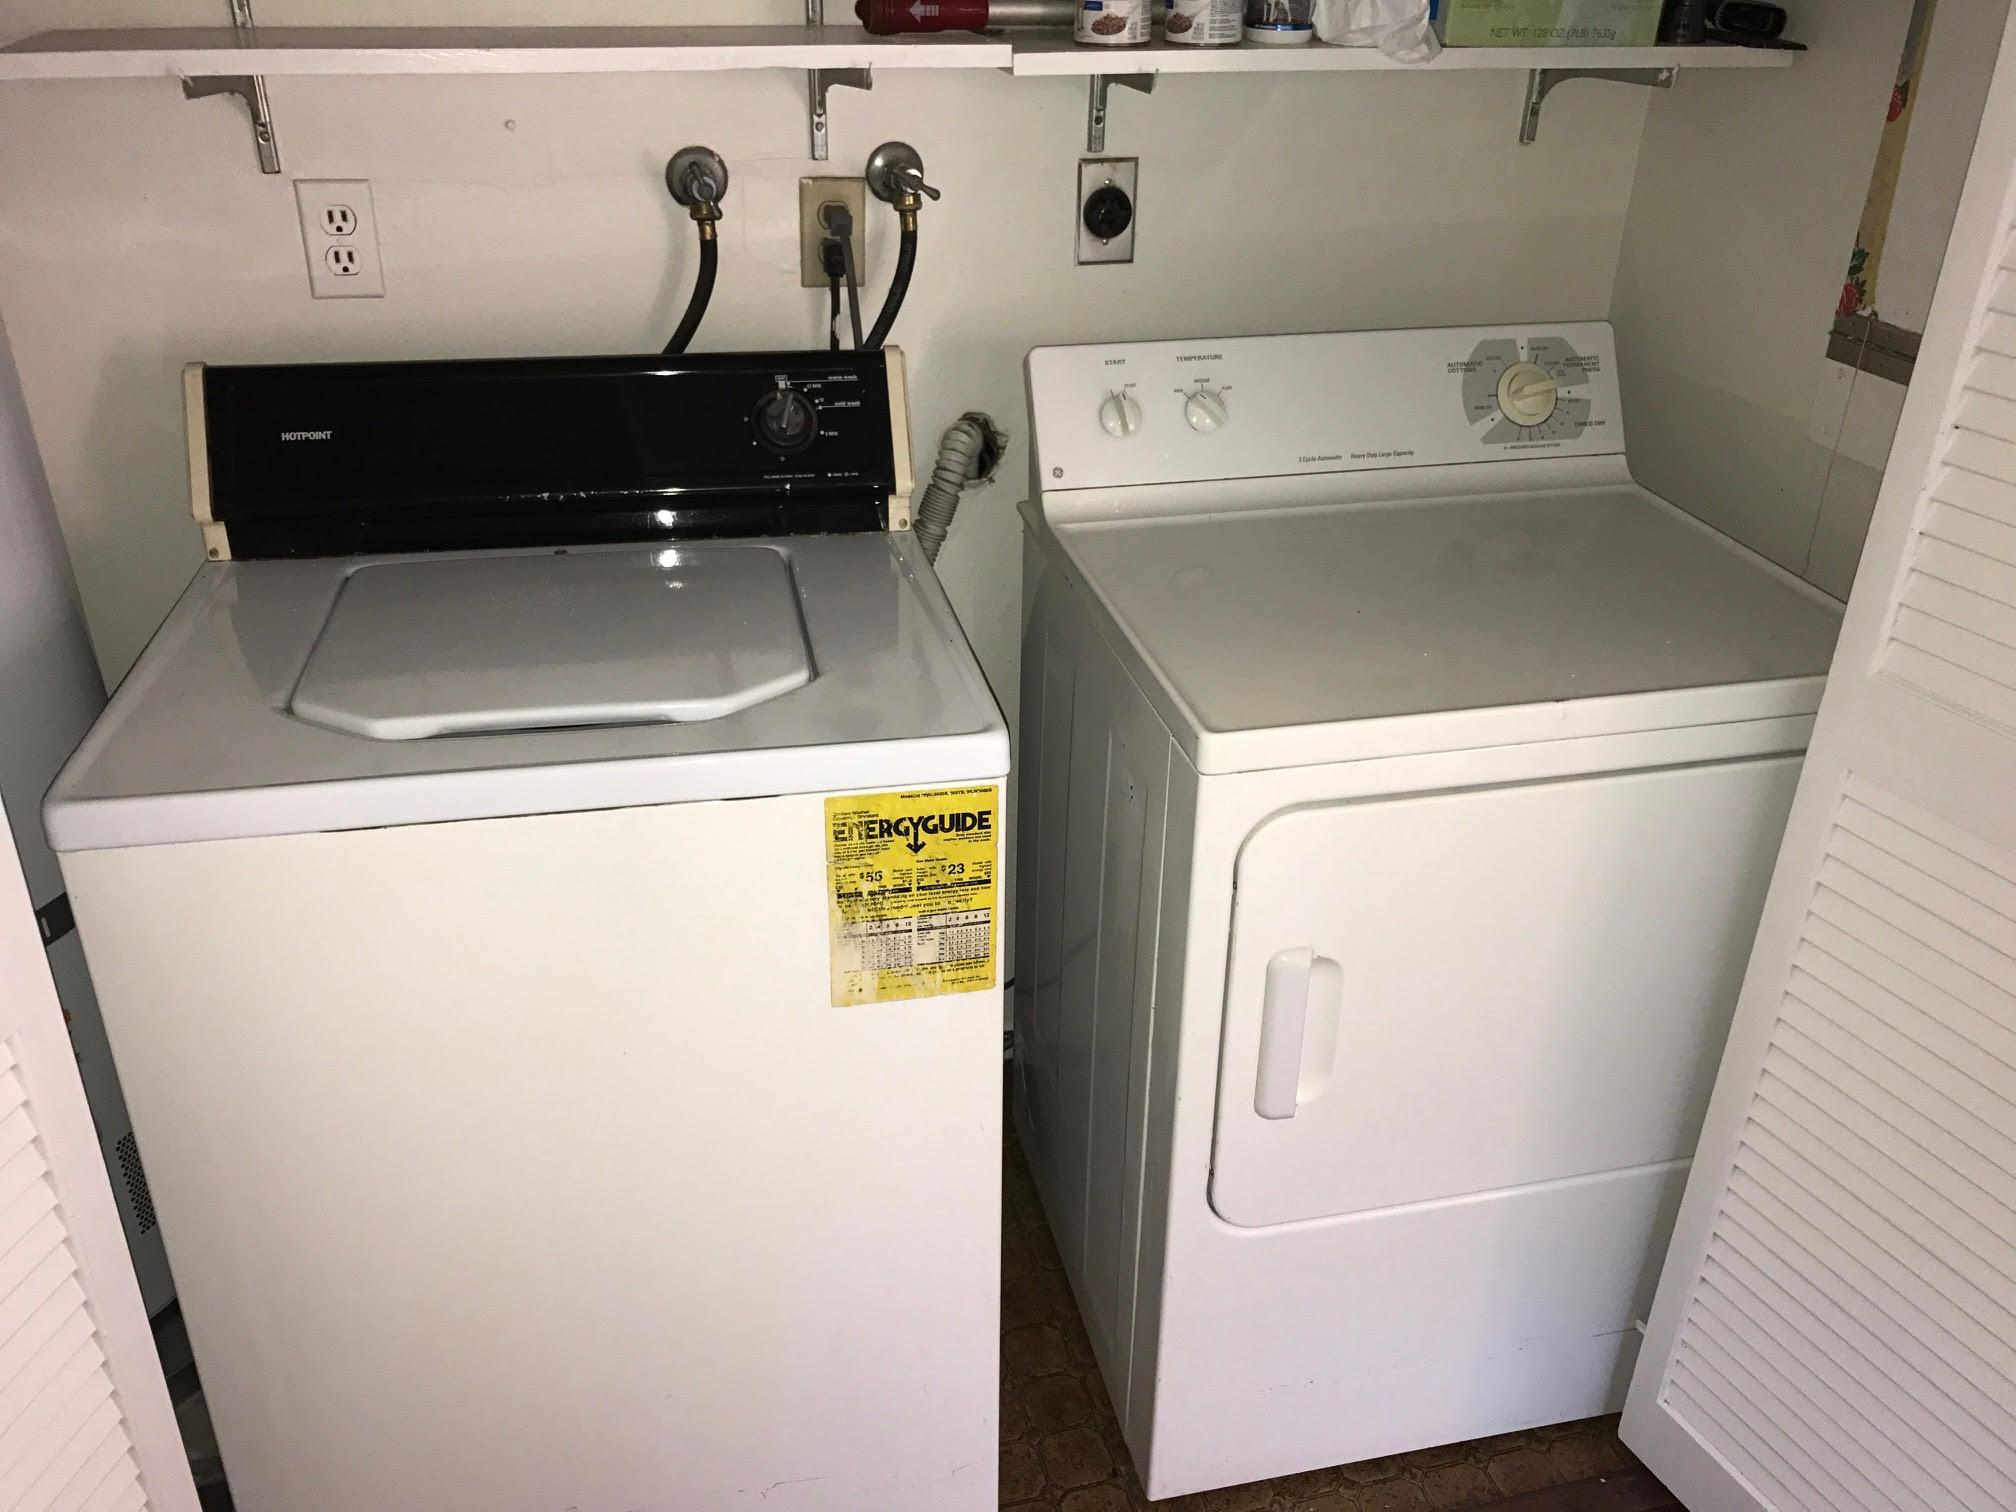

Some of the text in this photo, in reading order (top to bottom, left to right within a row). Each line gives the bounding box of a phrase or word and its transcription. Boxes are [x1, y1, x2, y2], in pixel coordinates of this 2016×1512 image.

[1489, 27, 1510, 39] NET
[1176, 354, 1223, 362] TEMPERATURE
[281, 430, 333, 441] HOTPOINT
[1317, 454, 1343, 462] Automatic
[1378, 451, 1392, 459] Large
[832, 810, 992, 843] ENERGYGUIDE
[941, 862, 965, 876] $23
